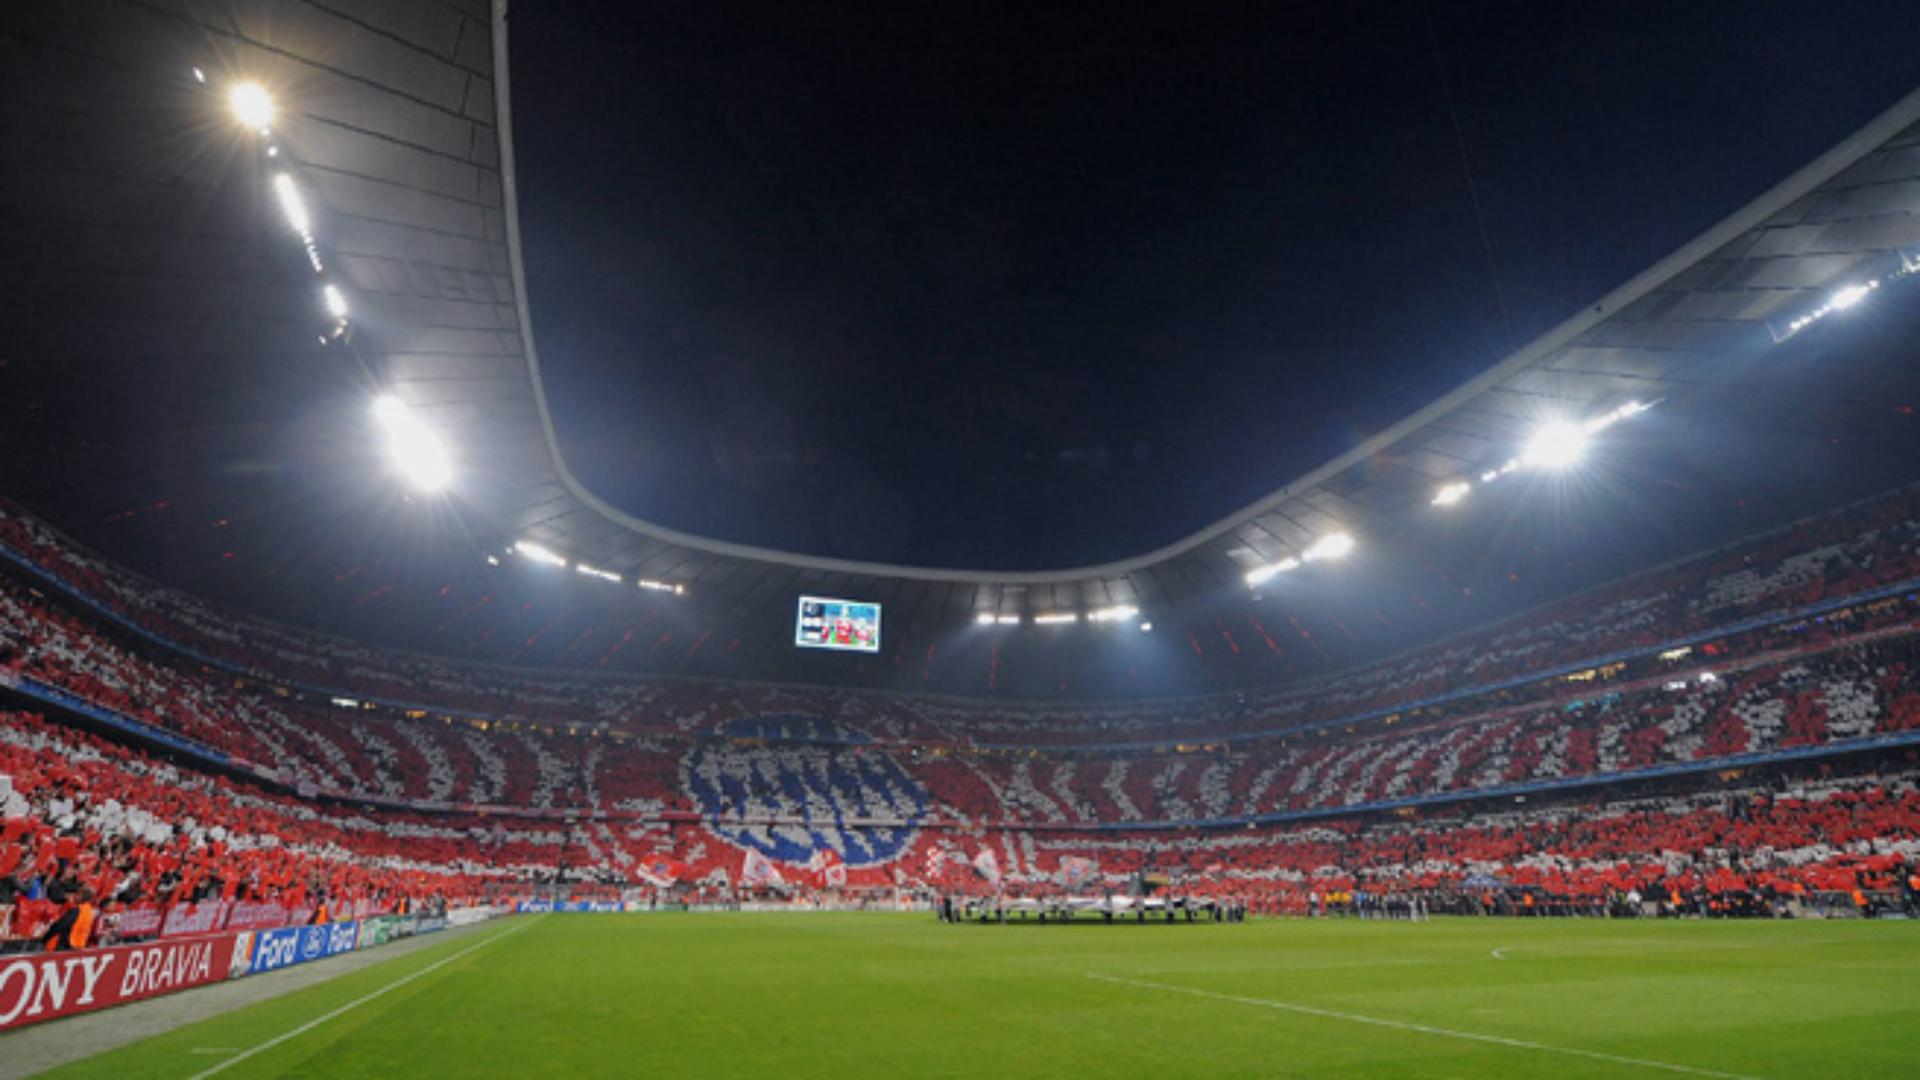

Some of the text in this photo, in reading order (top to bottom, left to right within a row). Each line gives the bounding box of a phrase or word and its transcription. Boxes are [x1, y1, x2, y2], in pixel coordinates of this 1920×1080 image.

[253, 927, 300, 970] Ford
[327, 923, 356, 953] Ford
[119, 941, 212, 996] BRAVIA
